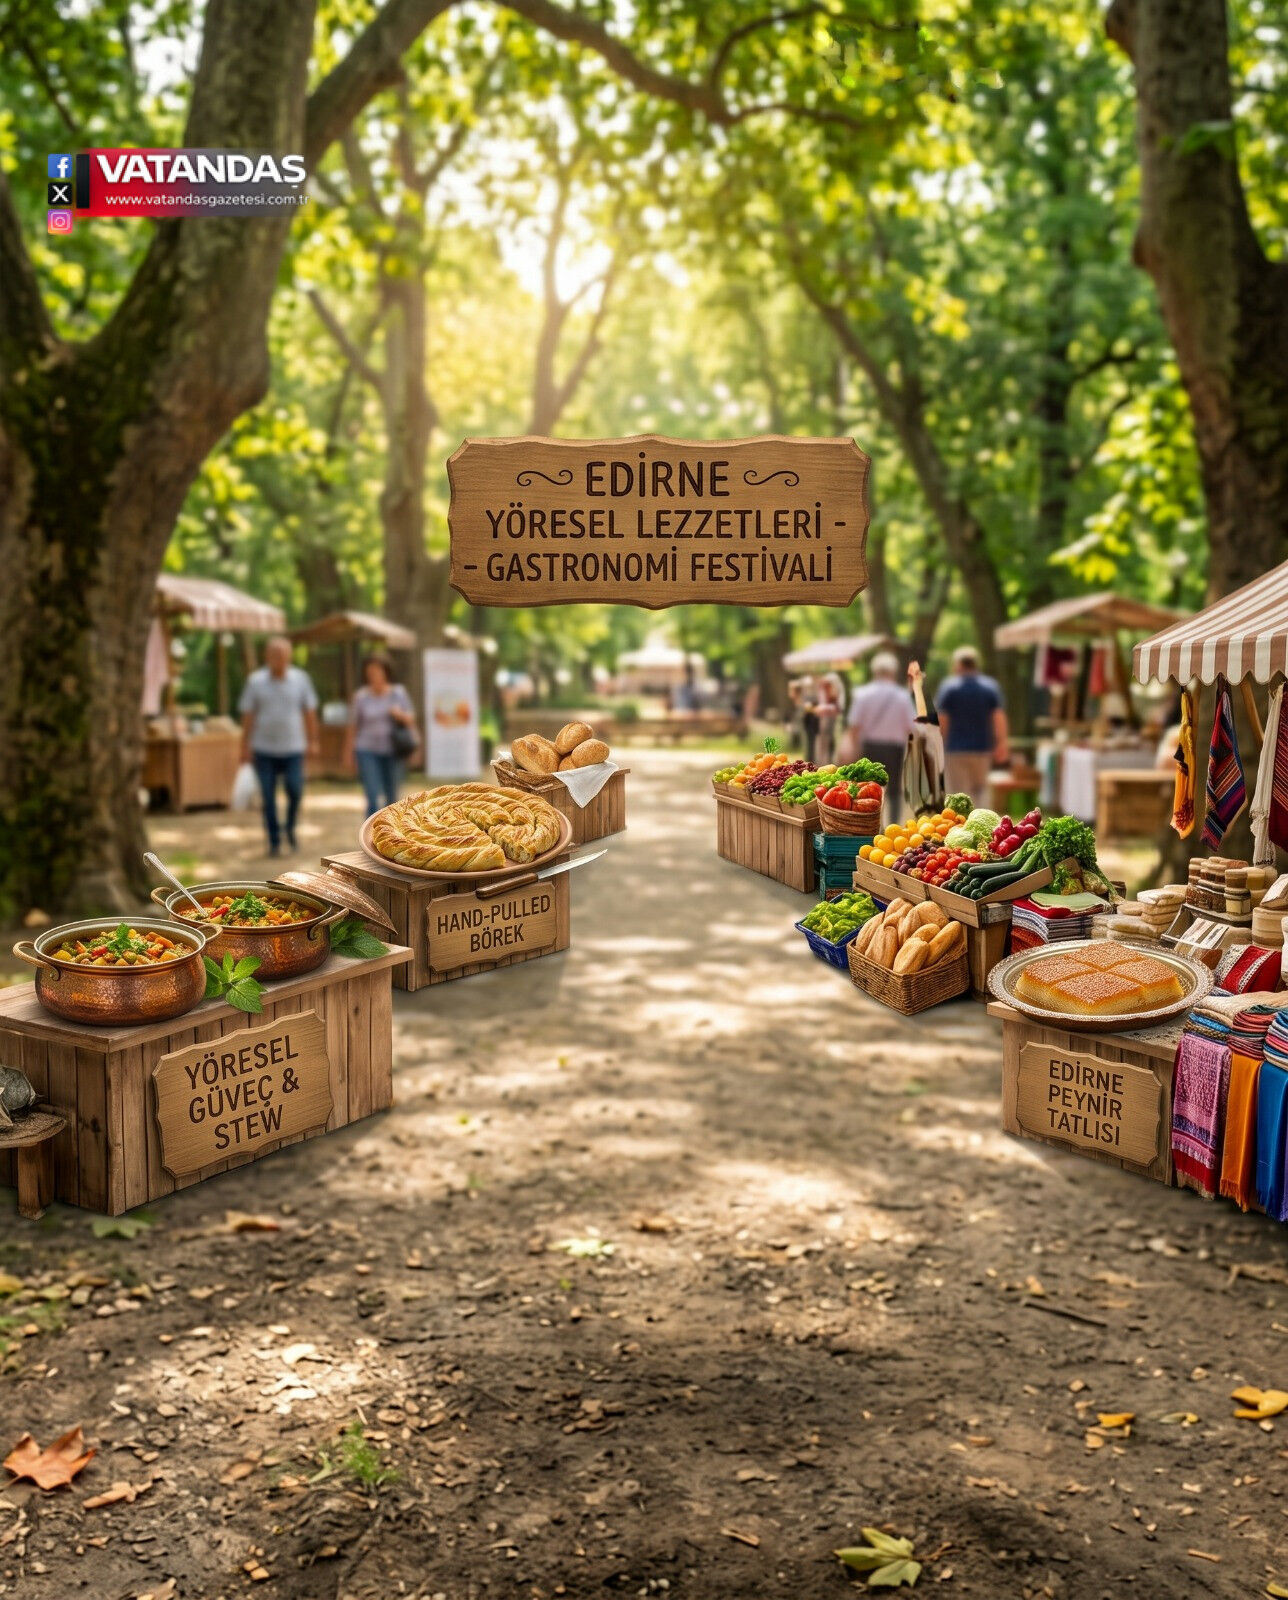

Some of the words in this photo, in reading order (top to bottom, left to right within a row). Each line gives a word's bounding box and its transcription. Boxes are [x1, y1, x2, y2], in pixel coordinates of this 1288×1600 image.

[586, 452, 730, 498] EDİRNE
[486, 502, 625, 539] YÖRESEL
[637, 502, 822, 539] LEZZETLERİ
[486, 546, 678, 582] GASTRONOMİ
[690, 546, 833, 582] FESTİVALİ
[437, 894, 551, 935] HAND-PULLED
[470, 923, 525, 953] BÖREK
[184, 1035, 299, 1090] YÖRESEL
[1049, 1059, 1124, 1095] EDİRNE
[189, 1074, 274, 1124] GÜVEÇ
[282, 1067, 300, 1094] &
[1048, 1084, 1122, 1121] PEYNİR
[214, 1104, 283, 1150] STEW
[1047, 1107, 1120, 1146] TATLISI
